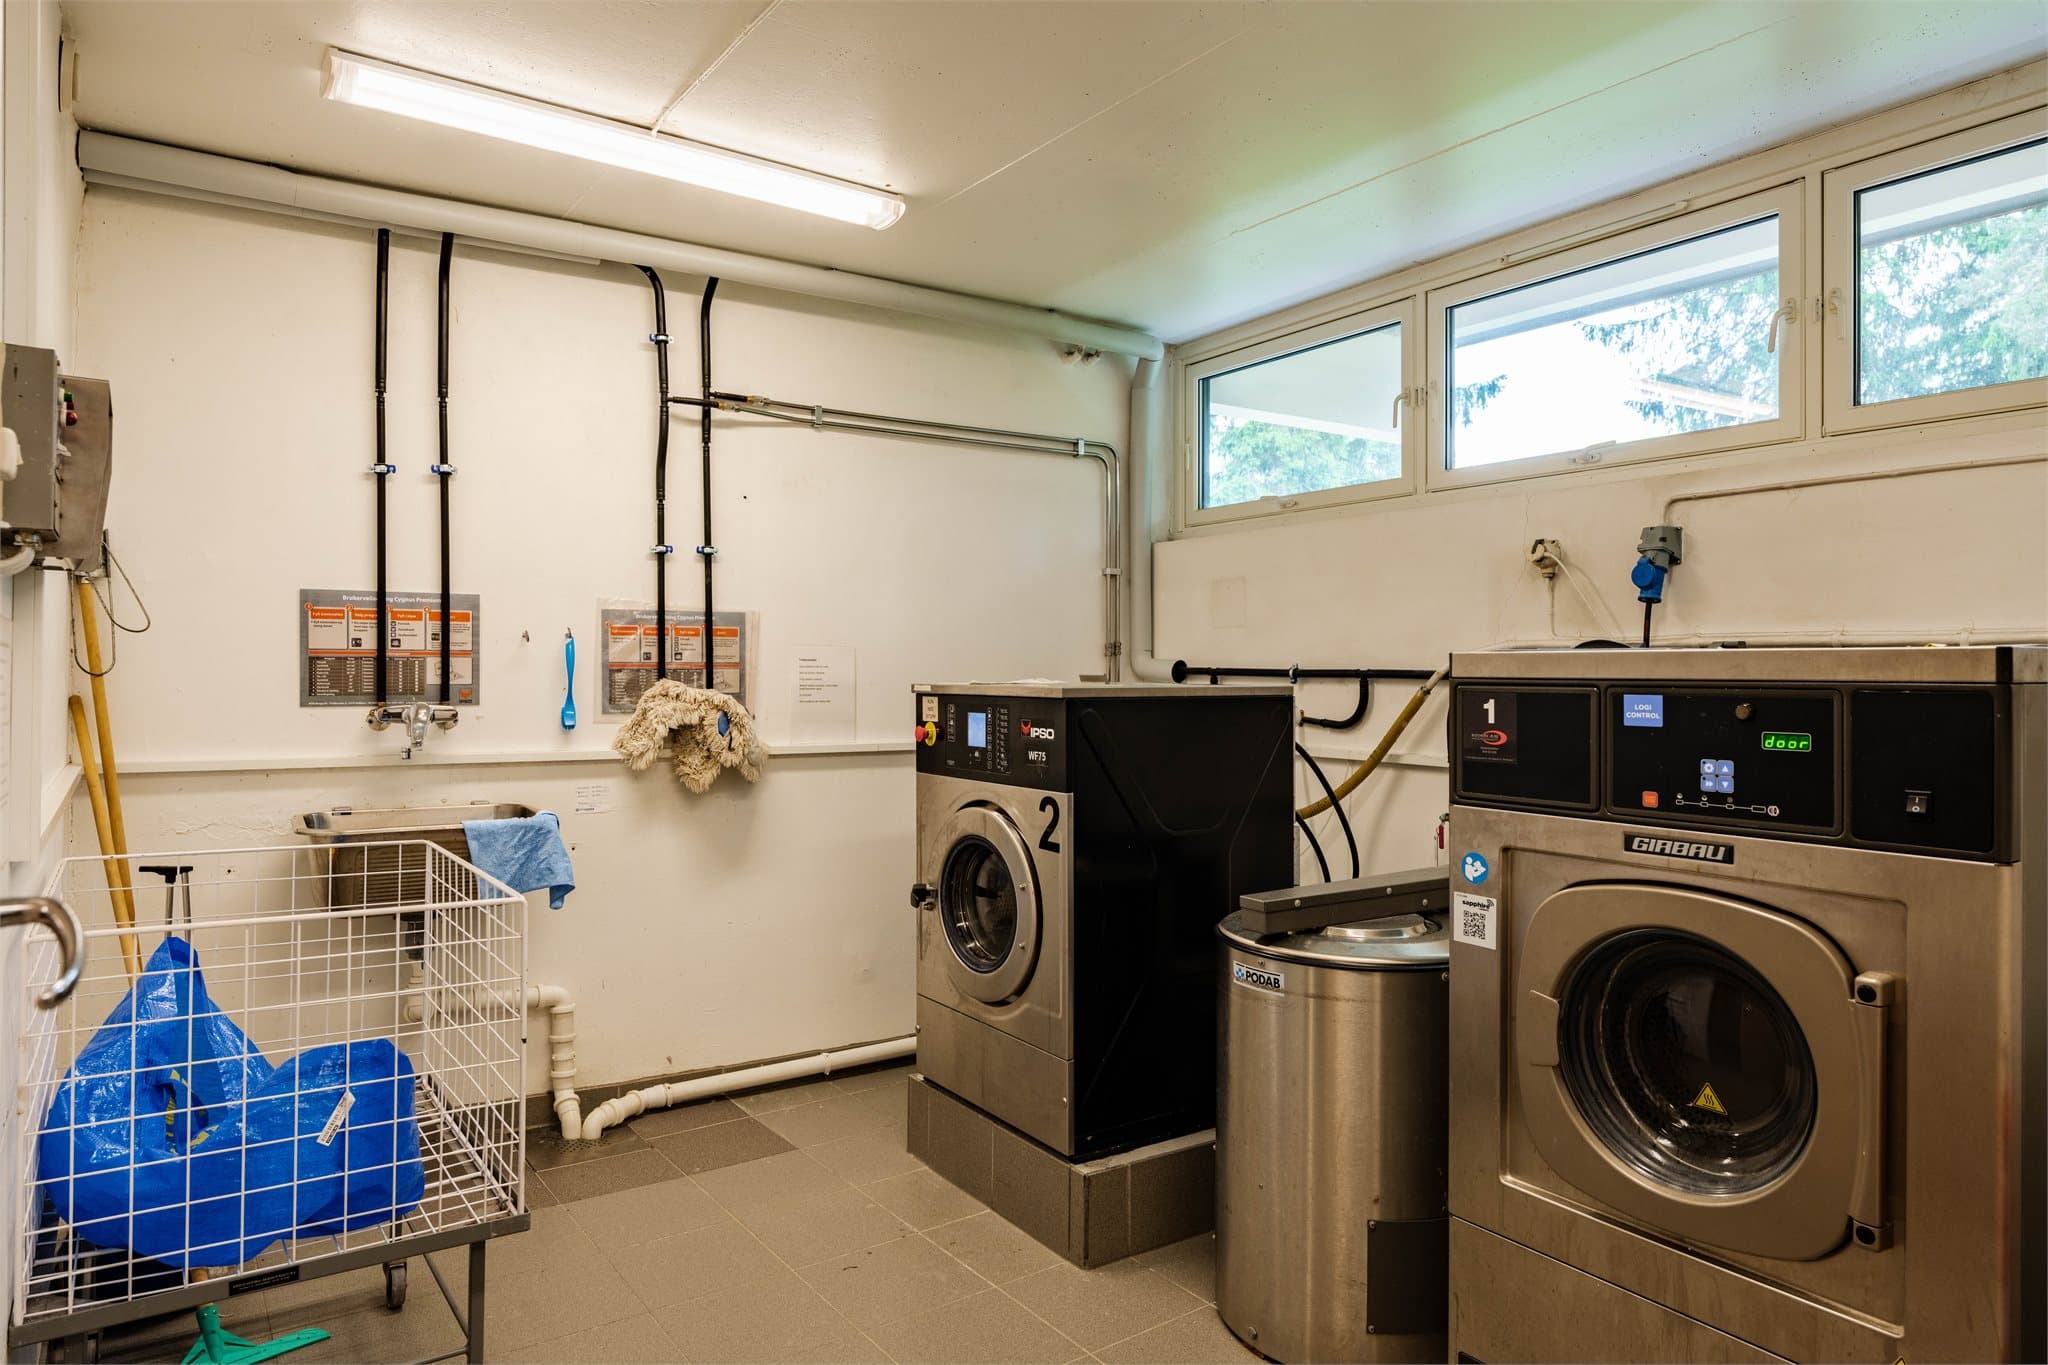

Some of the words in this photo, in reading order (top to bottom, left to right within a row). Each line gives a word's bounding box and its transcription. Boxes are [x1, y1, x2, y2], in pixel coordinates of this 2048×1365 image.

[1483, 699, 1495, 724] 1
[1030, 728, 1055, 740] IPSO
[1764, 736, 1808, 748] door
[1028, 751, 1046, 762] WF75
[1039, 796, 1060, 853] 2
[1632, 837, 1726, 861] GIRBAU
[1462, 900, 1490, 909] sapphire
[1246, 971, 1280, 988] PODAB
